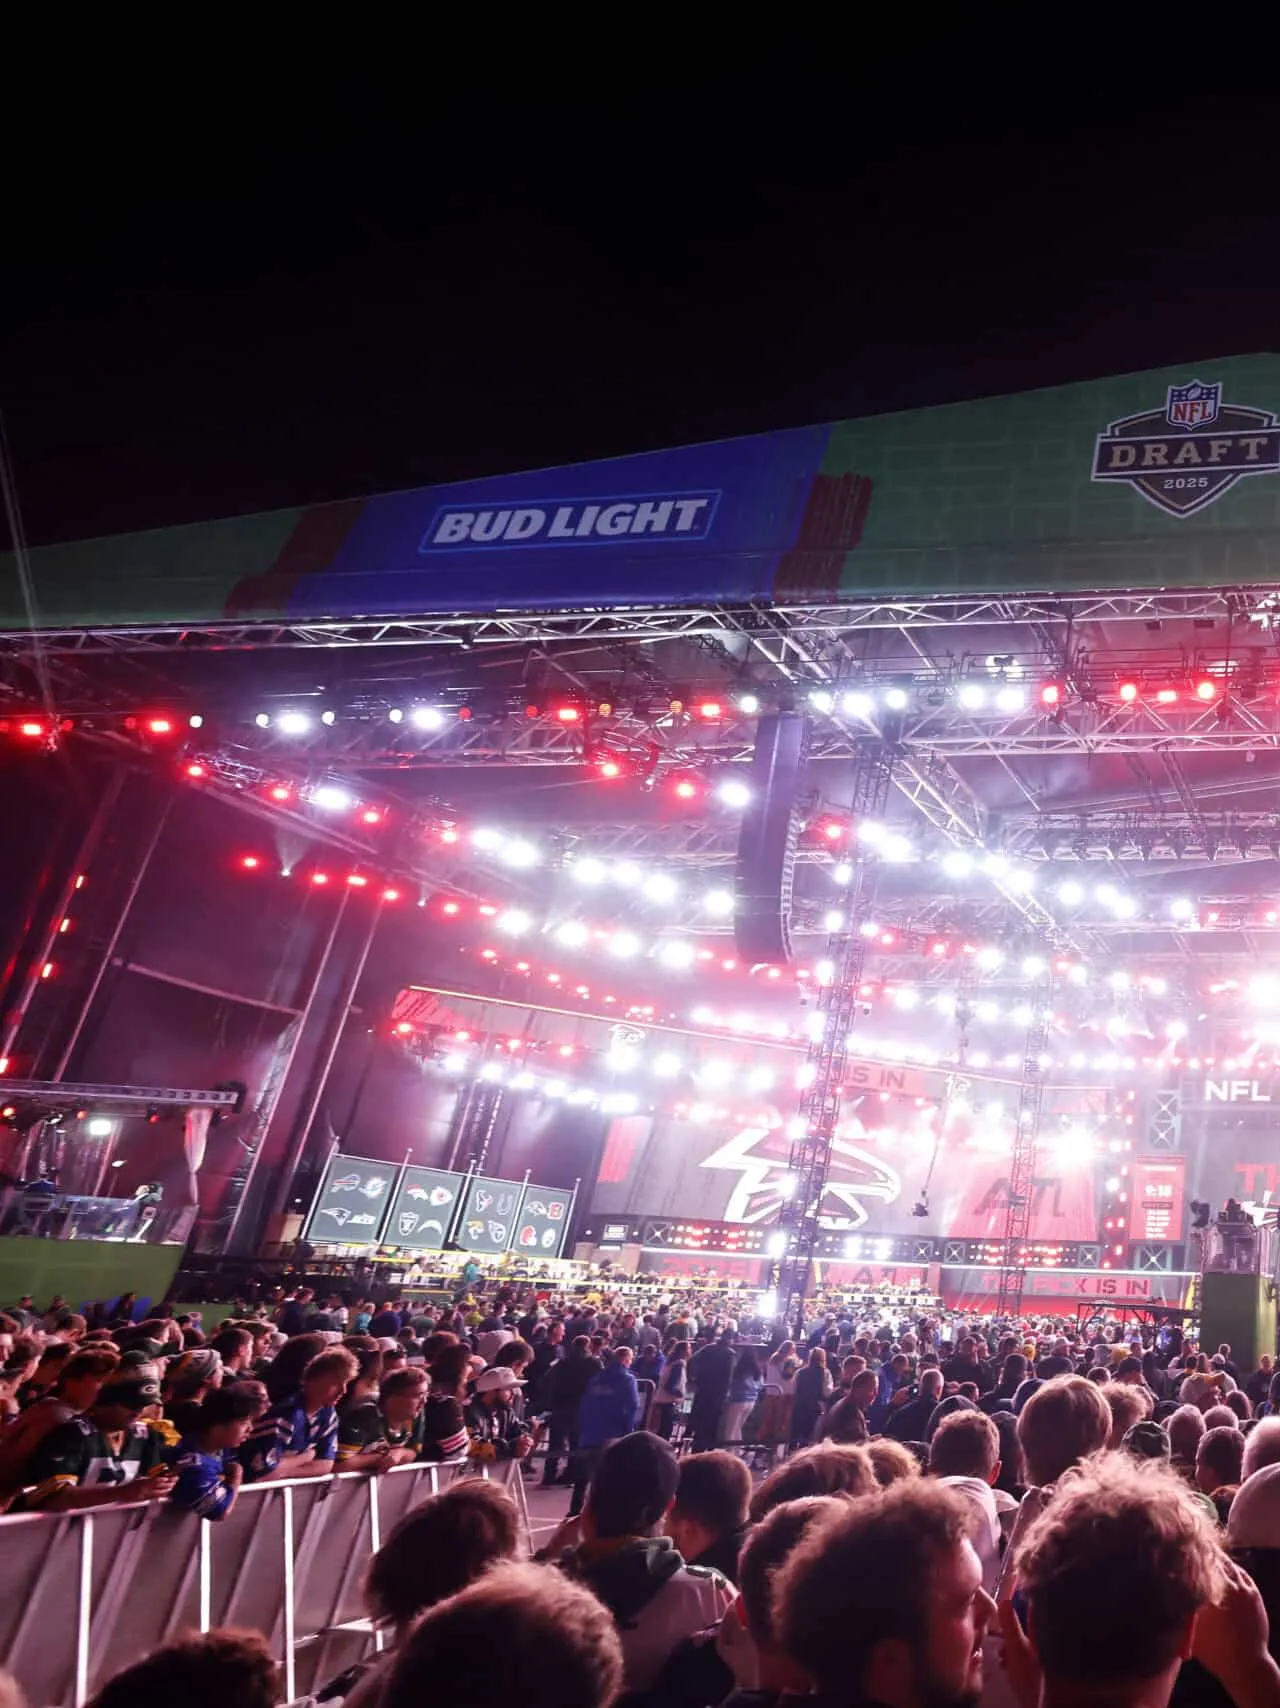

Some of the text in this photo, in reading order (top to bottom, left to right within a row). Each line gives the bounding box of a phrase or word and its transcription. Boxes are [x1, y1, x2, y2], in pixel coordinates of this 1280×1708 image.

[1171, 401, 1212, 422] NFL
[1108, 436, 1271, 468] DRAFT
[1163, 477, 1209, 490] 2025
[432, 499, 709, 543] BUD LIGHT
[879, 1069, 906, 1089] IN
[1203, 1079, 1271, 1103] NFL
[1095, 1279, 1118, 1295] IS
[1126, 1279, 1148, 1296] IN
